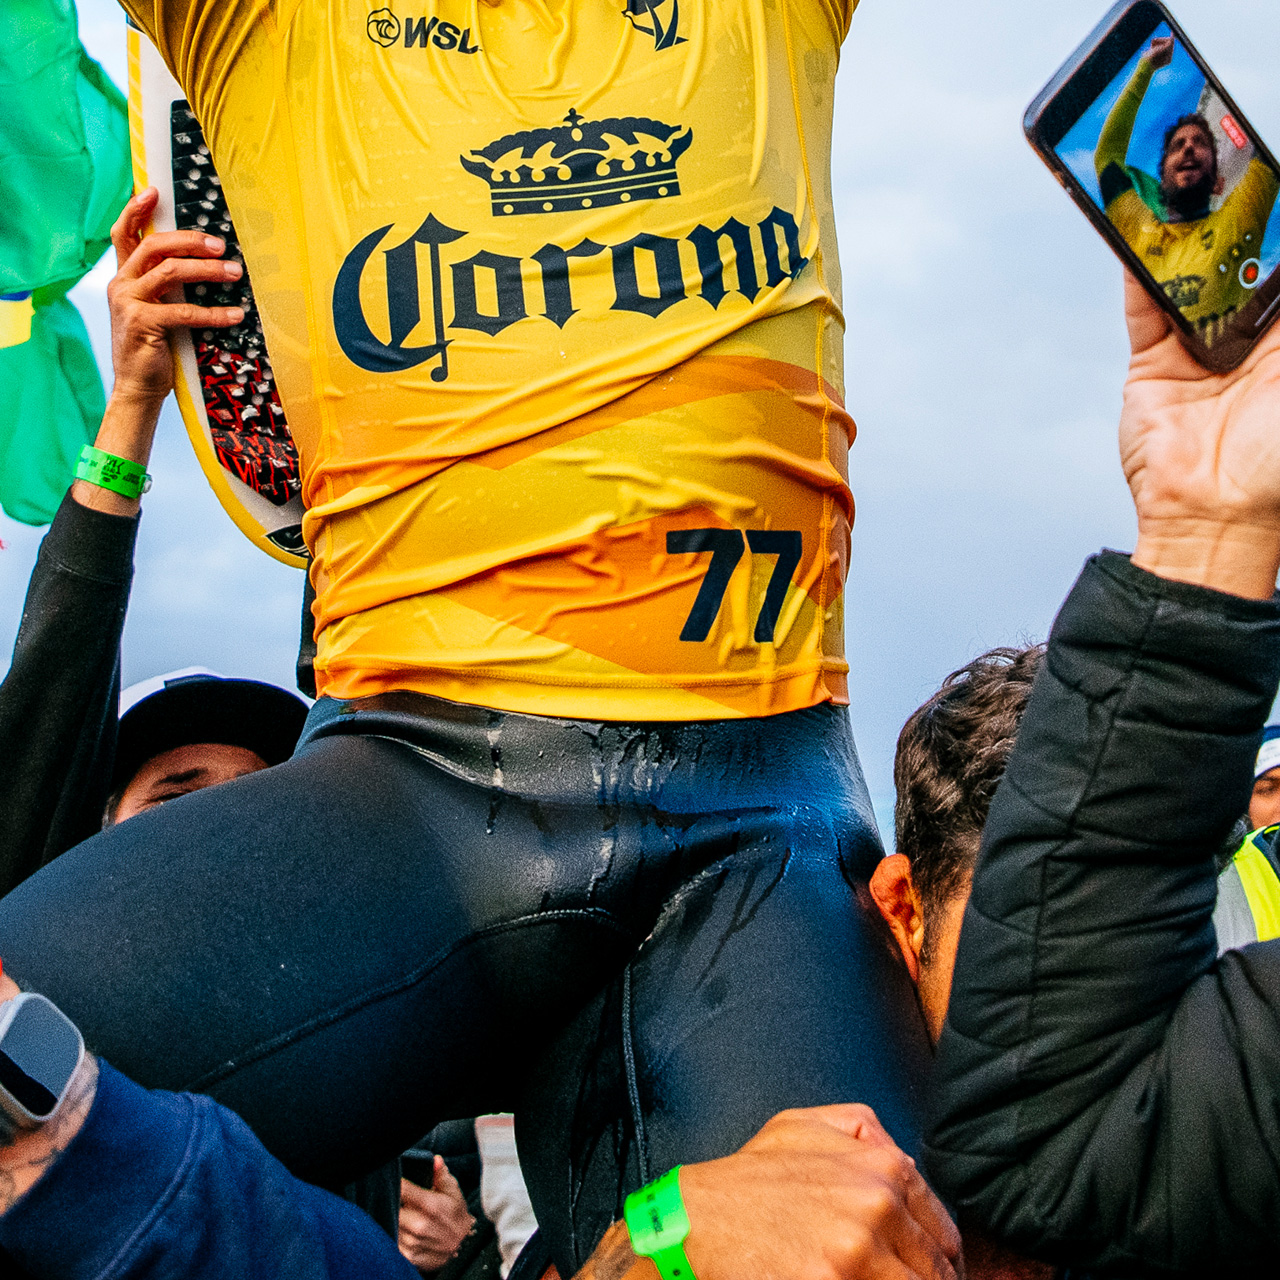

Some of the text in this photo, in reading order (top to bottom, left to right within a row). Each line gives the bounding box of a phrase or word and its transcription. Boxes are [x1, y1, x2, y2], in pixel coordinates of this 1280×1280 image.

[403, 15, 479, 55] WSL
[331, 205, 811, 383] Corona
[665, 527, 803, 644] 77
